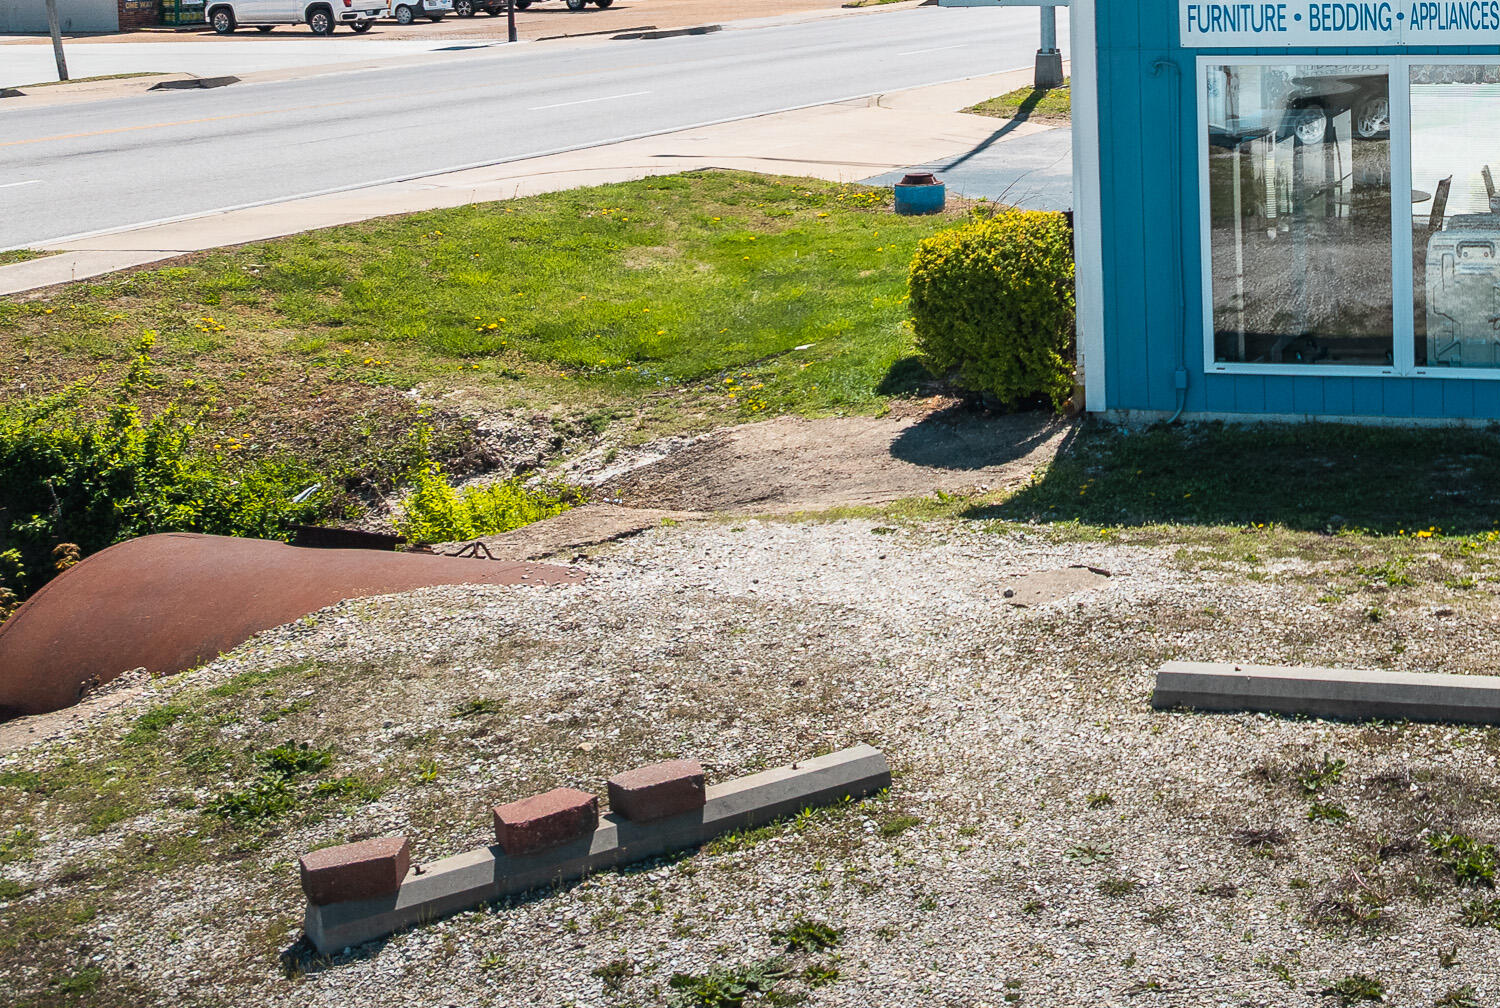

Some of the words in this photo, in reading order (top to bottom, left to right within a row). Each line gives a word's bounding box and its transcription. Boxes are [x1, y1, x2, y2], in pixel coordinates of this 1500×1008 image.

[1187, 4, 1288, 33] FURNITURE
[1309, 2, 1392, 32] BEDDING
[1409, 1, 1500, 31] APPLIANCES
